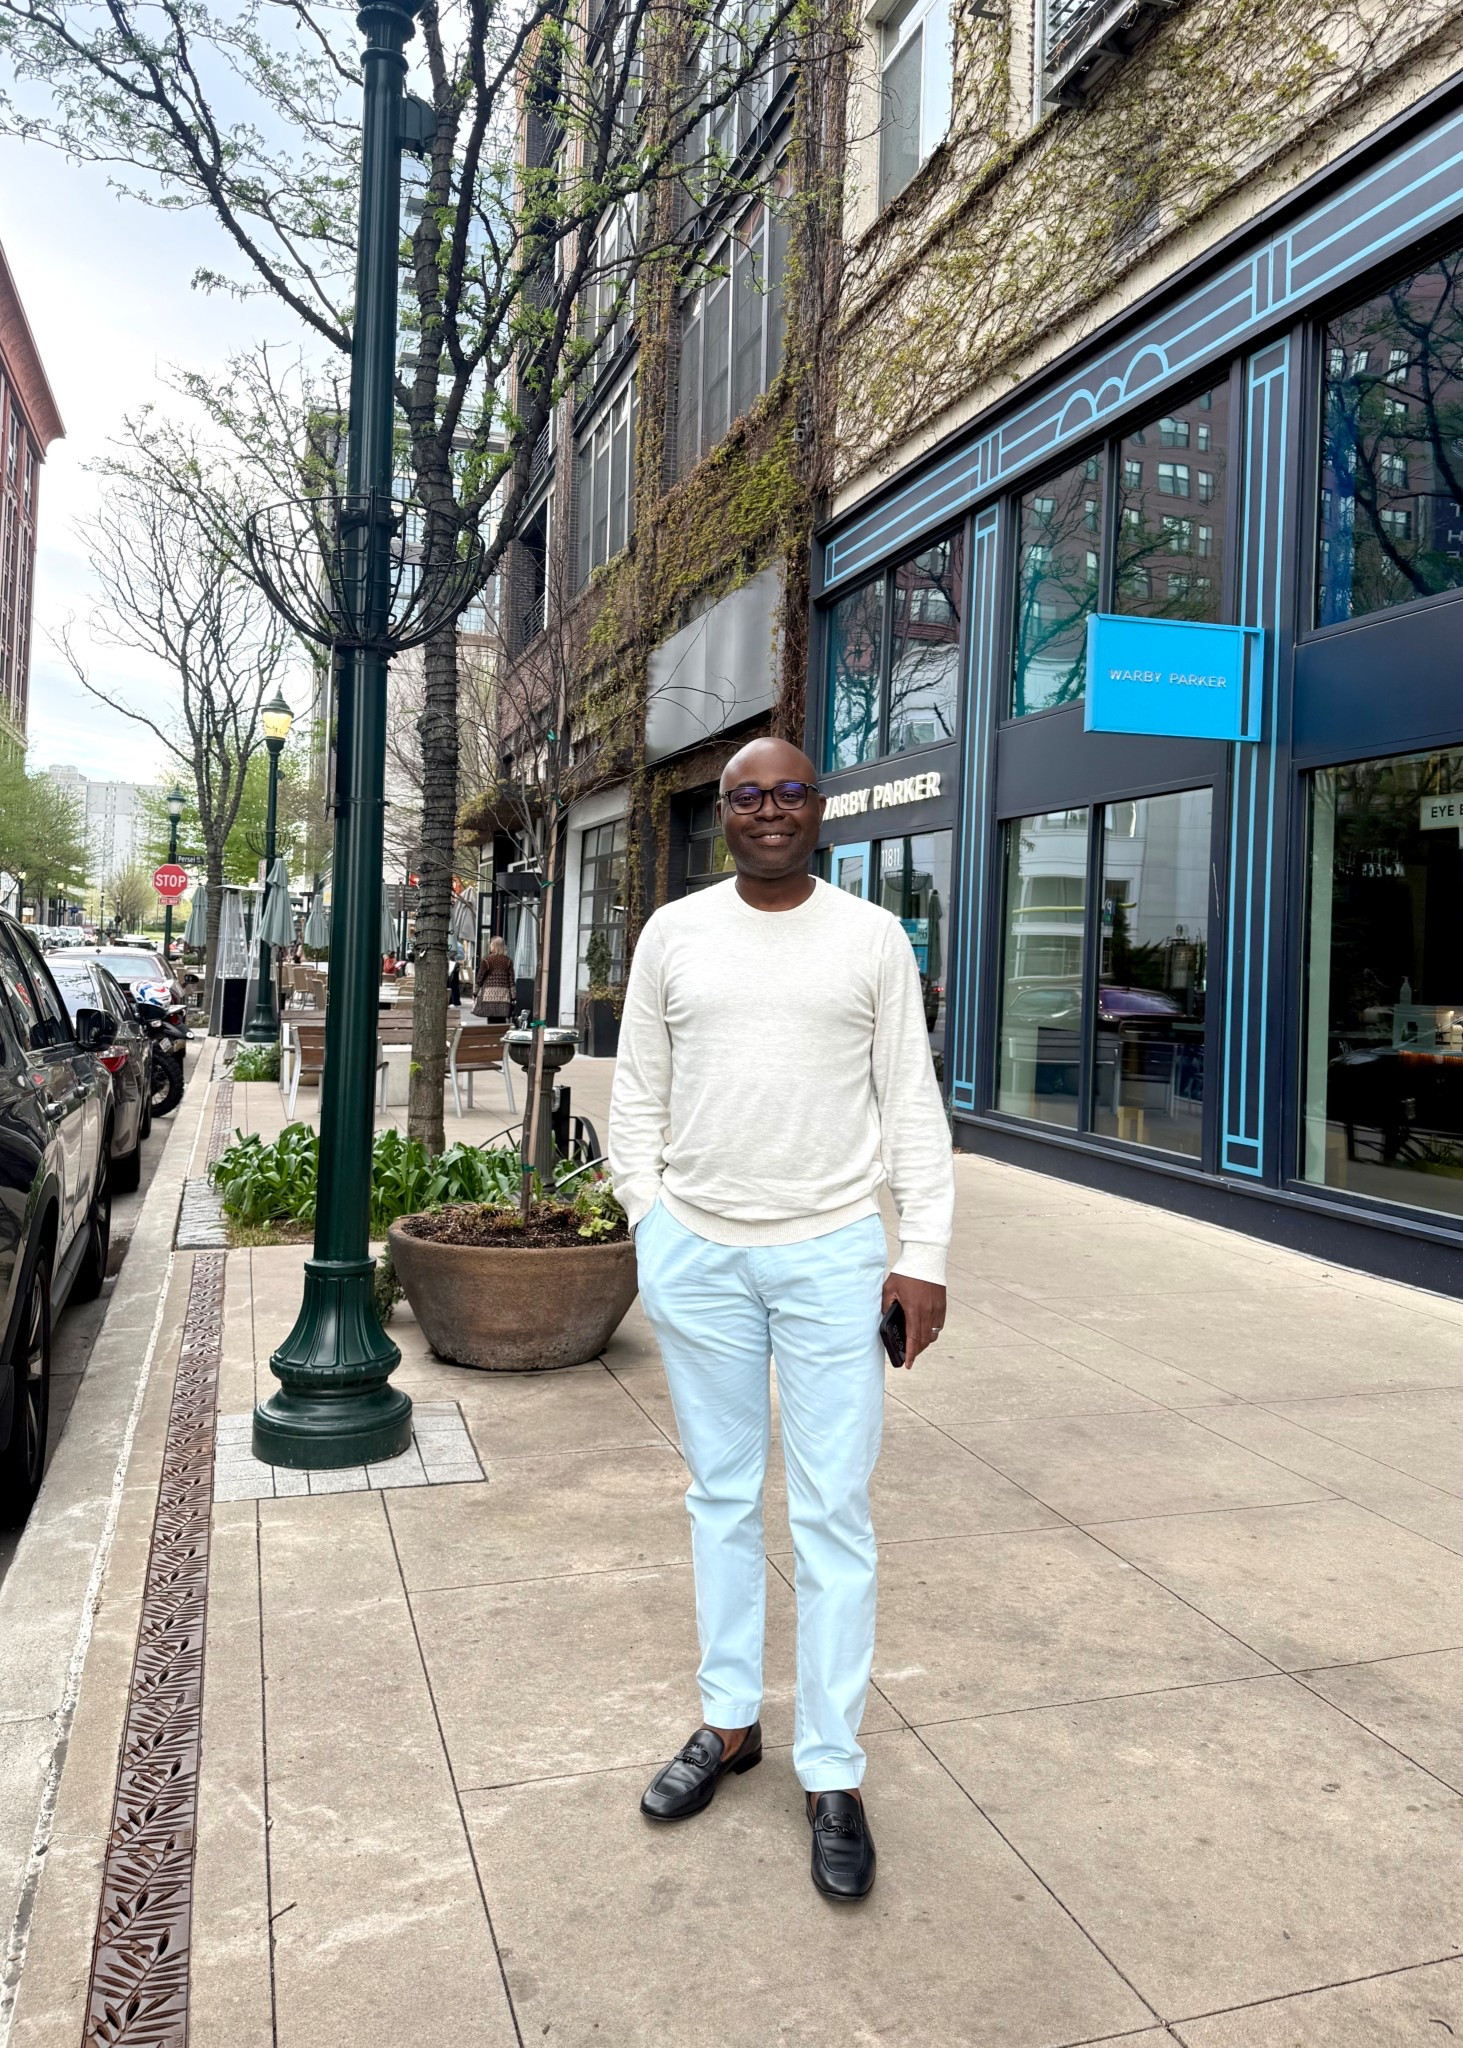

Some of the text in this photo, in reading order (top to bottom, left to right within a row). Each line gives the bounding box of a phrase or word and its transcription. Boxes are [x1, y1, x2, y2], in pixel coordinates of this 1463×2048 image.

[1109, 668, 1227, 688] WARBY PARKER
[873, 771, 941, 810] PARKER
[1431, 804, 1454, 818] EYE
[881, 848, 900, 867] 11811
[155, 874, 187, 888] STOP
